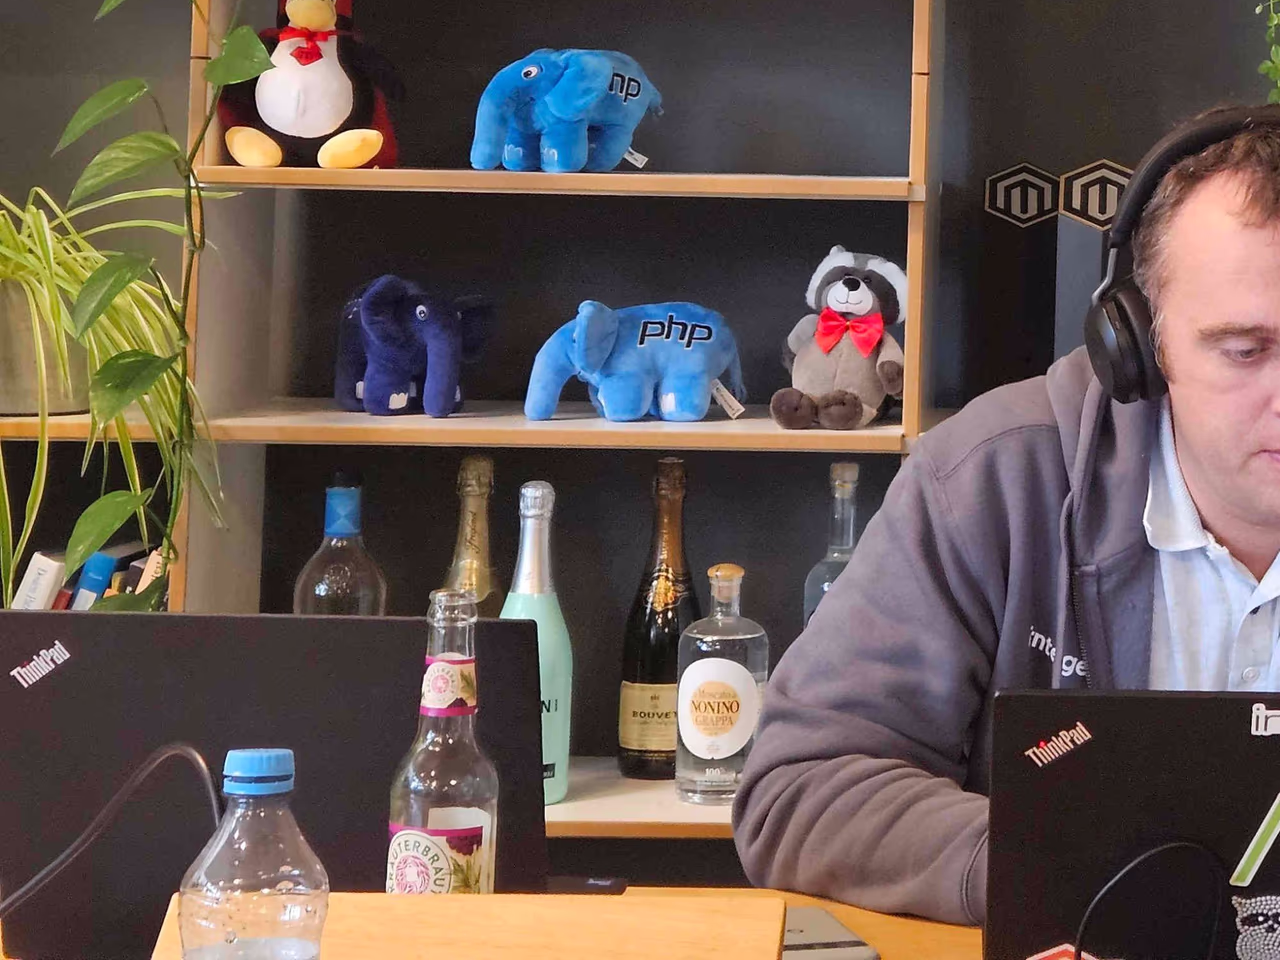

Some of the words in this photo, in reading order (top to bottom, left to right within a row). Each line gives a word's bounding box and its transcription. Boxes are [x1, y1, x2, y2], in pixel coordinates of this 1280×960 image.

[638, 315, 713, 349] php
[10, 640, 71, 688] ThinkPad
[691, 700, 740, 714] NONINO
[695, 715, 734, 727] GRAPPA
[1025, 722, 1092, 768] ThinkPad
